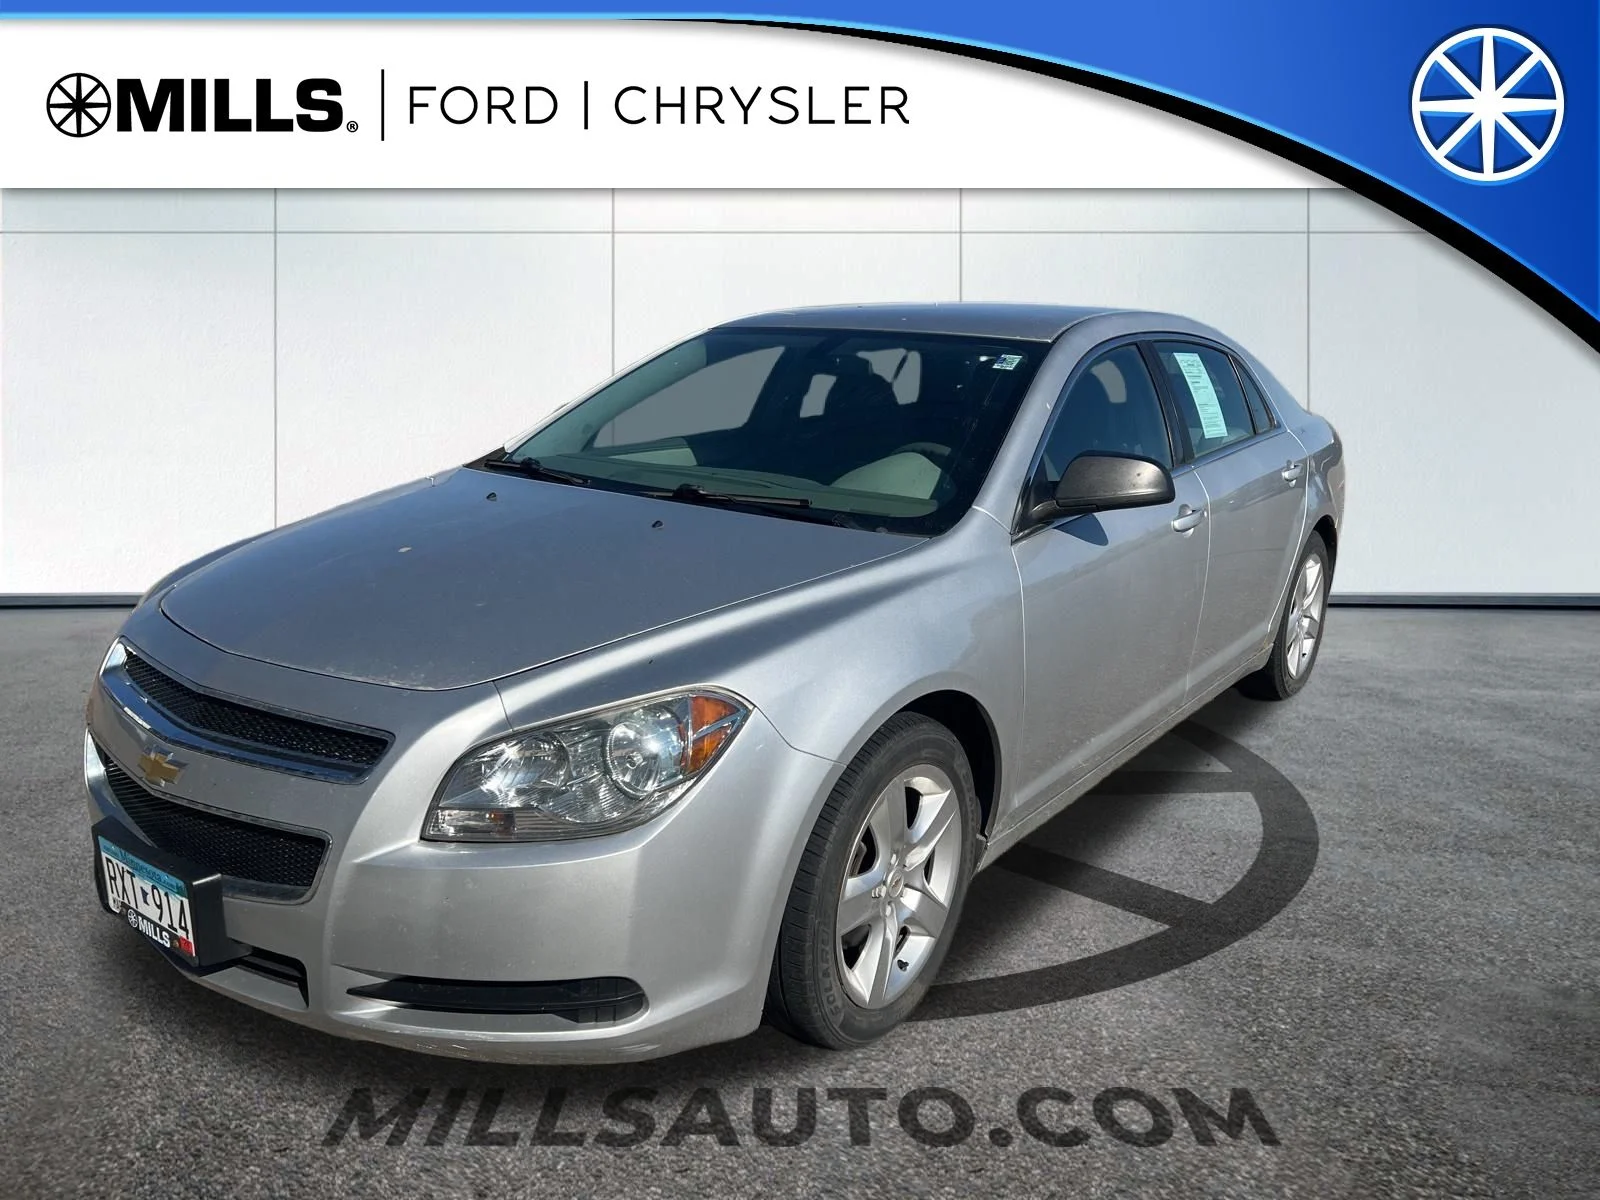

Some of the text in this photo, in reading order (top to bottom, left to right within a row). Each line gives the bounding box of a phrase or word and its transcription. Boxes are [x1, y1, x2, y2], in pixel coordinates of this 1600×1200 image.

[106, 857, 190, 939] RXT 914
[138, 917, 171, 948] MILLS
